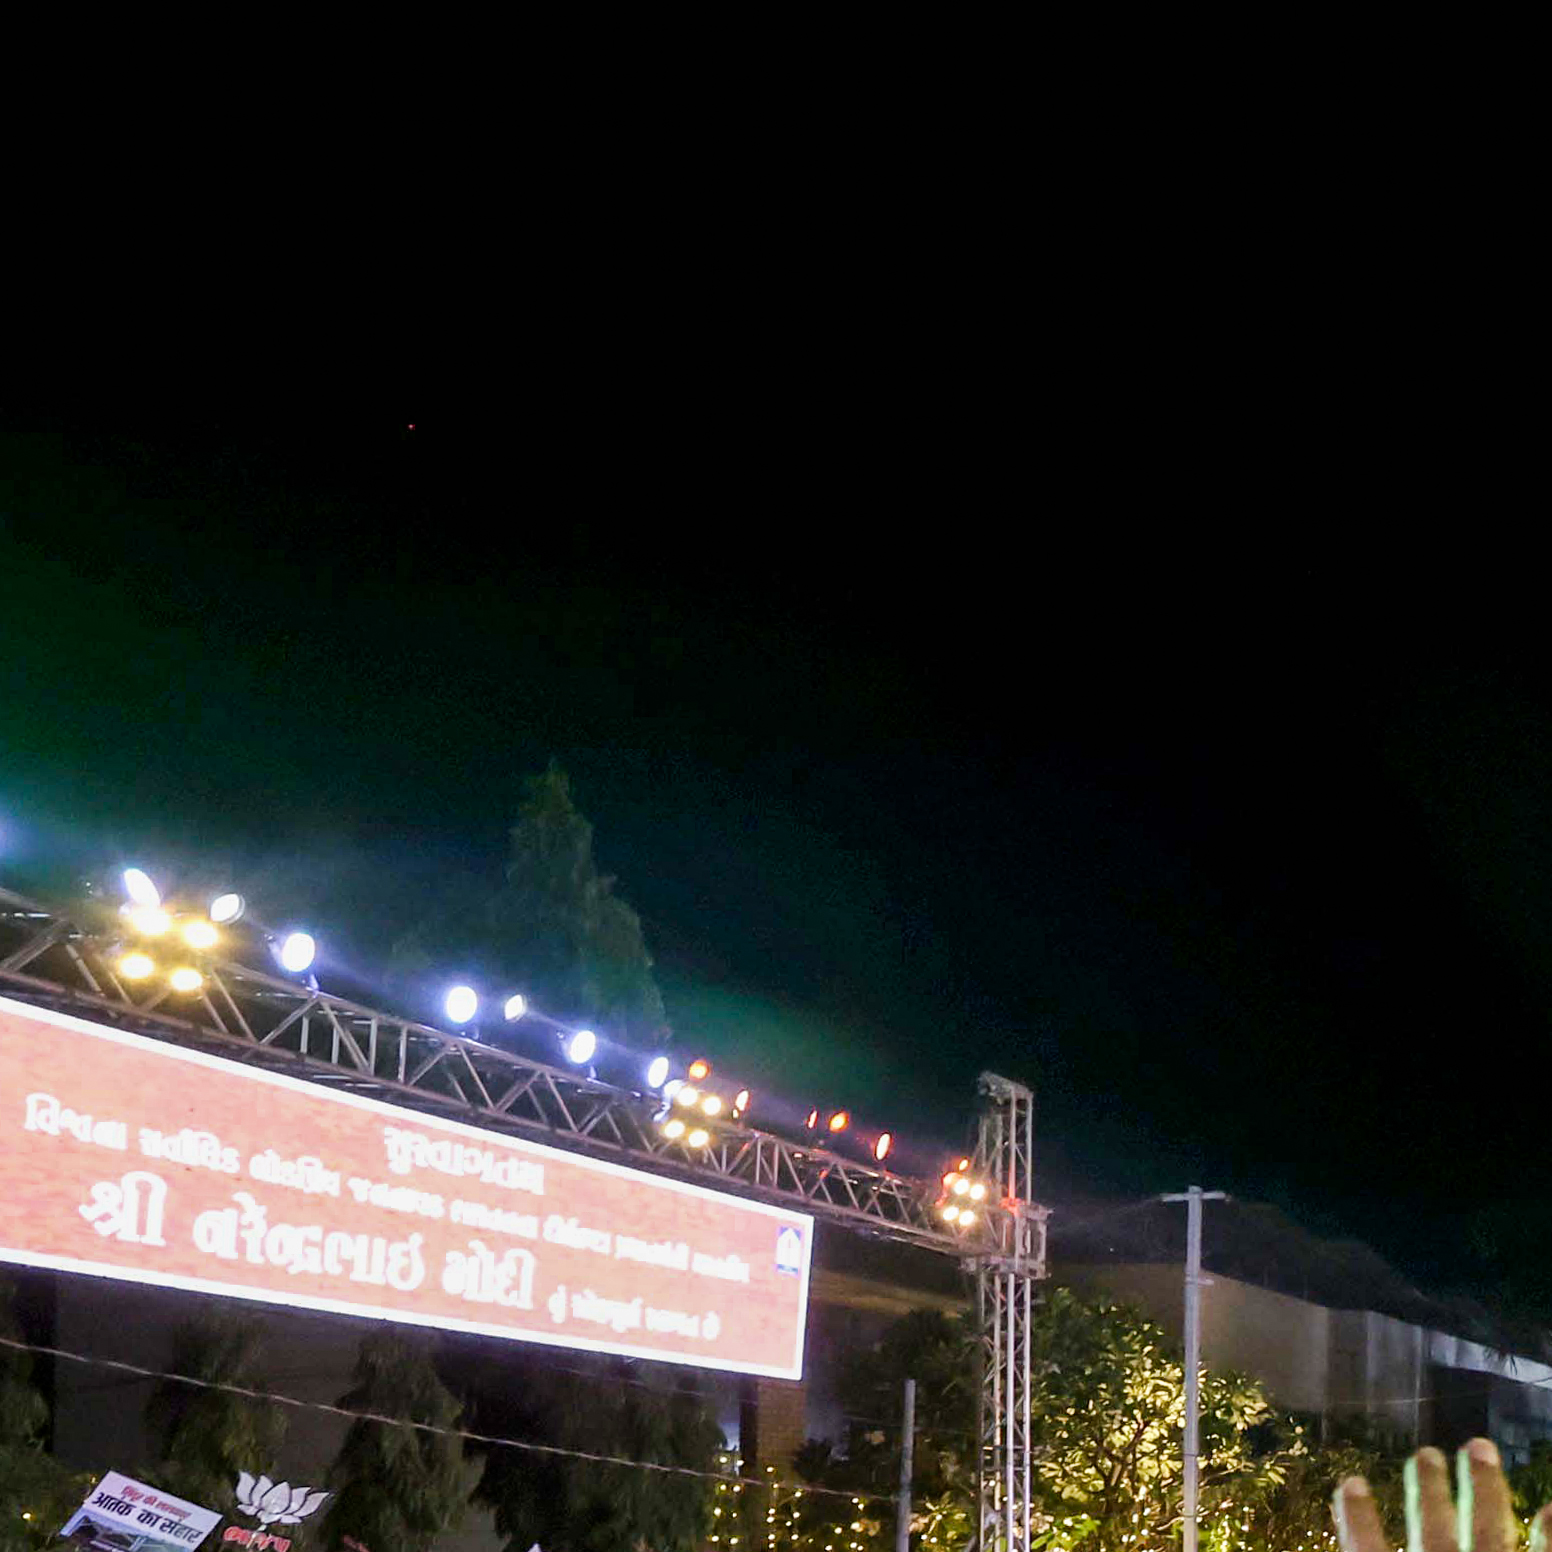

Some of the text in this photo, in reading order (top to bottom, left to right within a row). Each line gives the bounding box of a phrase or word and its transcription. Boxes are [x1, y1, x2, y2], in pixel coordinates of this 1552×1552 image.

[78, 1171, 166, 1245] શ્રી
[442, 1239, 534, 1308] મોદી
[136, 1508, 161, 1528] का
